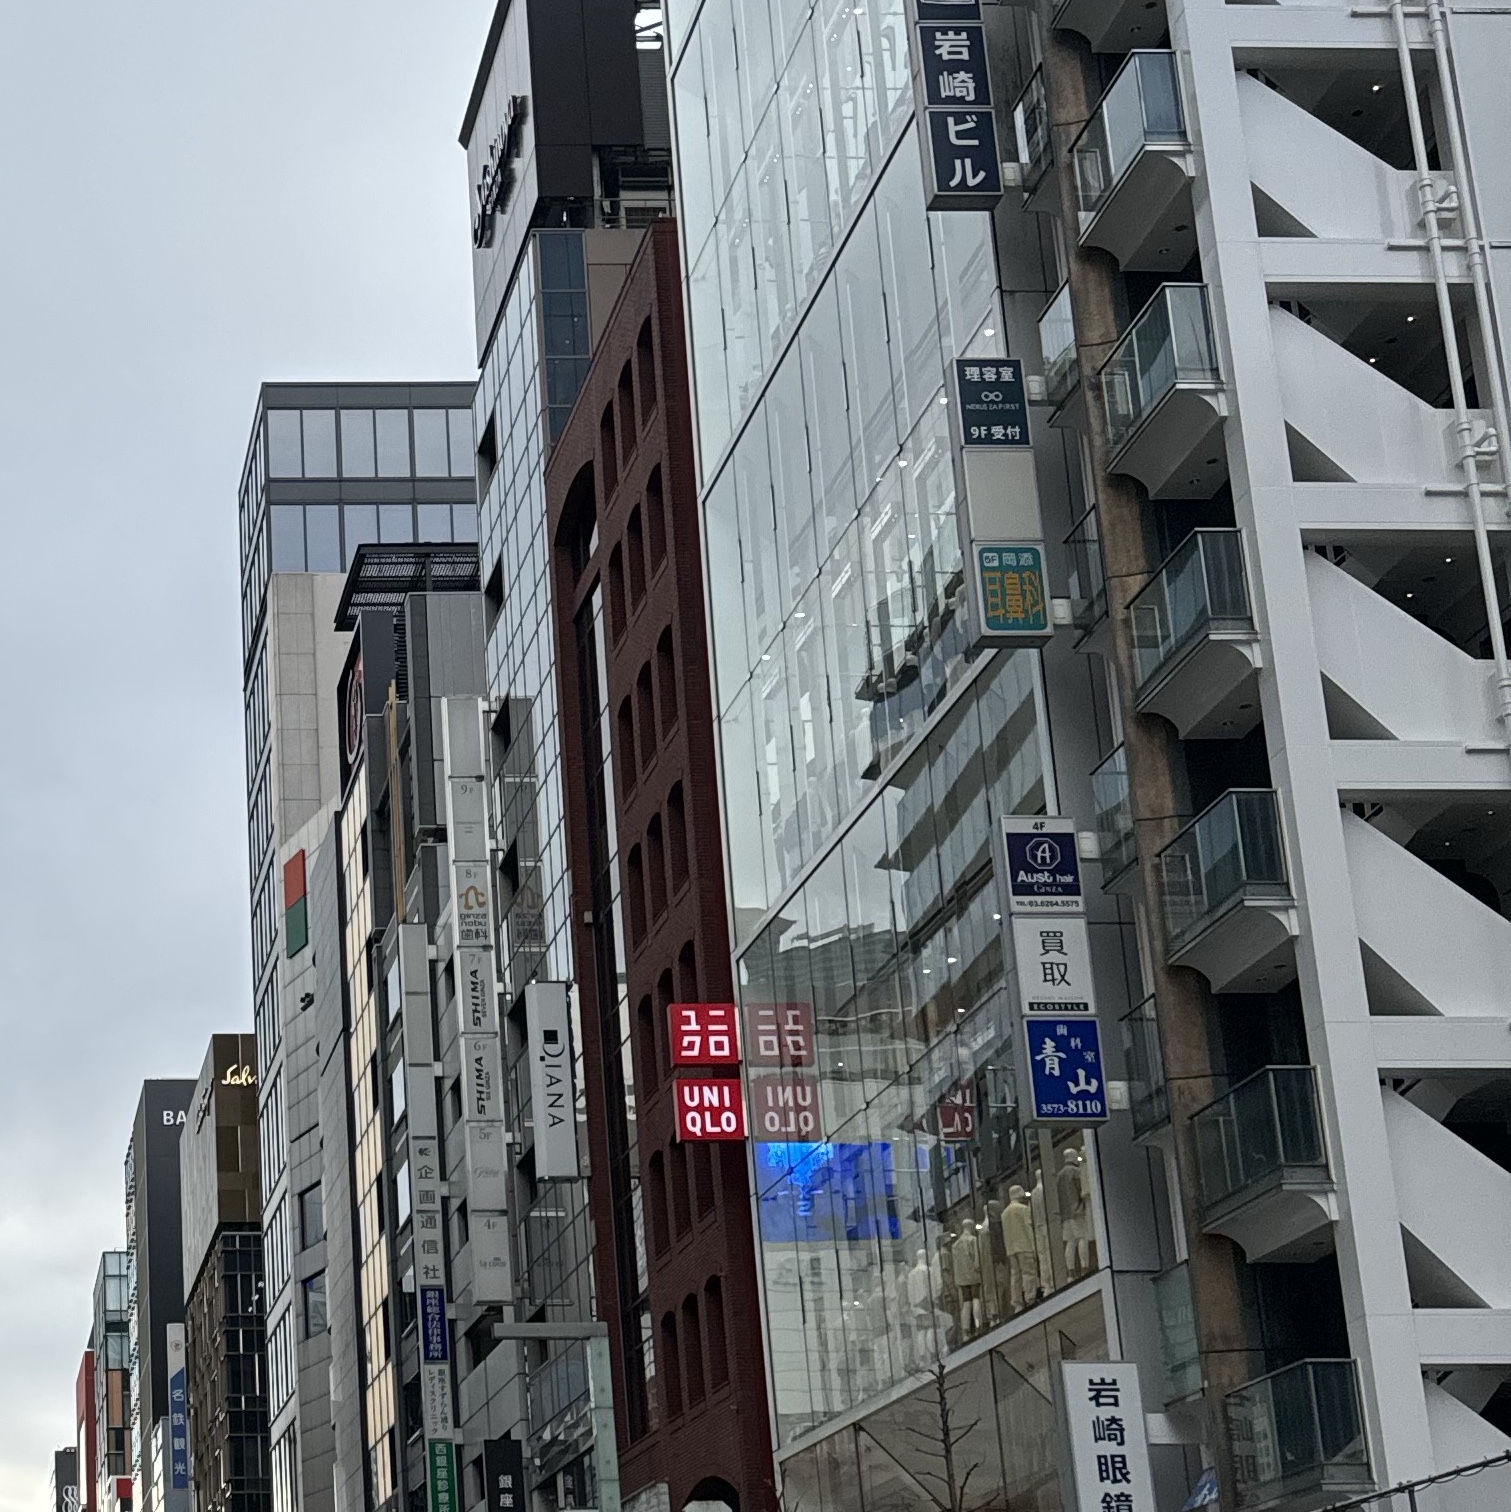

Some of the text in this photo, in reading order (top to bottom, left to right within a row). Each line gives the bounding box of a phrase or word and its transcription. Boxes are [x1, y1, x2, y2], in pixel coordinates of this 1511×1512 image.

[934, 31, 986, 187] 岩崎ビル
[964, 366, 1015, 382] 理容室
[983, 571, 1045, 624] 耳鼻科
[1032, 822, 1046, 831] 4F
[1039, 931, 1071, 986] 買取
[470, 969, 481, 1027] SHIMA
[221, 1064, 257, 1086] Salv
[475, 1056, 486, 1116] SHIMA
[541, 1030, 565, 1128] DIANA
[1034, 1037, 1099, 1095] 青山
[163, 1110, 187, 1126] BA
[683, 1086, 731, 1107] UNI
[1040, 1099, 1102, 1114] 3573-8110
[685, 1111, 737, 1136] QLO
[417, 1165, 441, 1280] 企画通信社
[172, 1388, 186, 1475] 名鉄観光
[498, 1475, 514, 1508] 銀座
